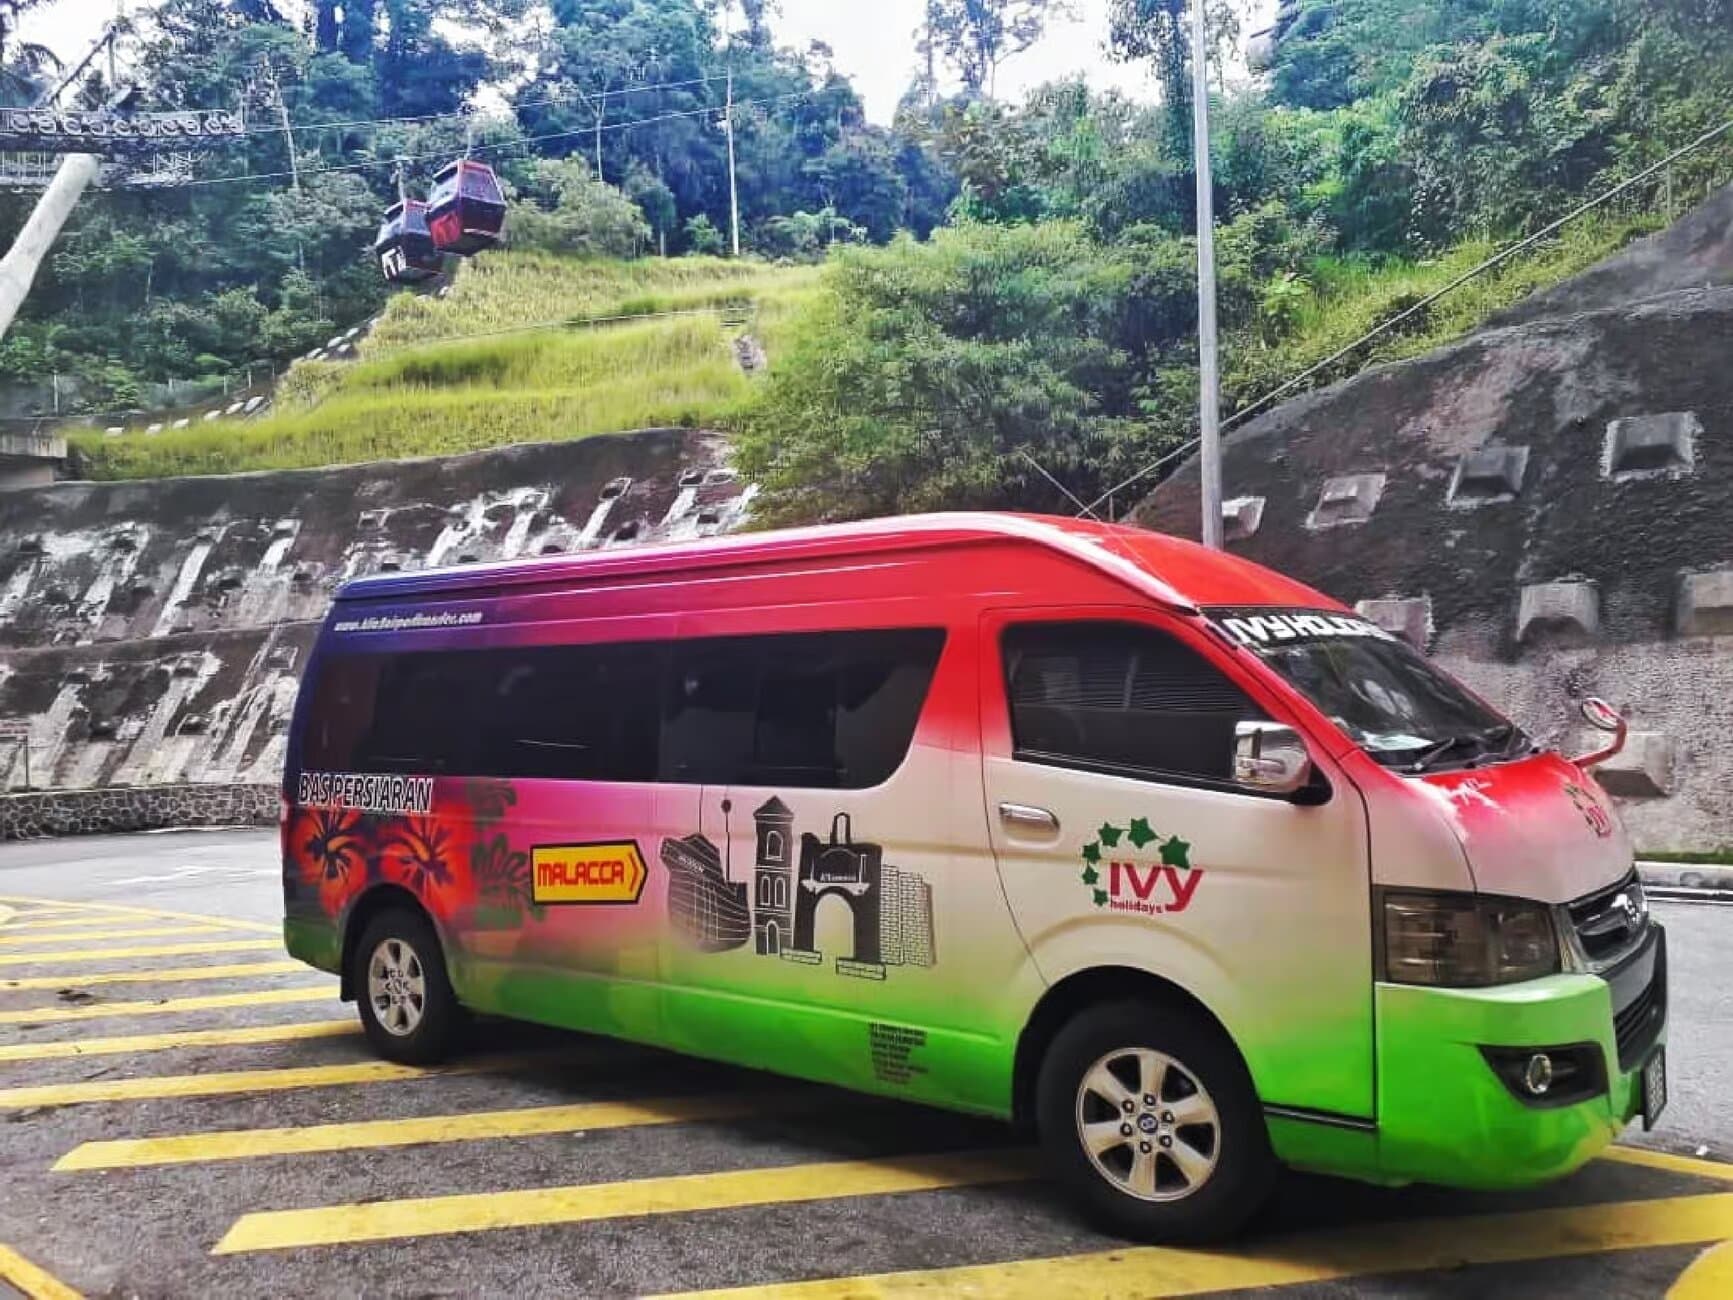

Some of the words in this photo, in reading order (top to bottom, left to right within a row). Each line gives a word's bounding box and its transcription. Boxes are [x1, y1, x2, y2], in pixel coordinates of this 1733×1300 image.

[299, 772, 331, 806] BAS
[332, 774, 433, 813] PERSIARAN
[537, 860, 625, 887] MALACCA
